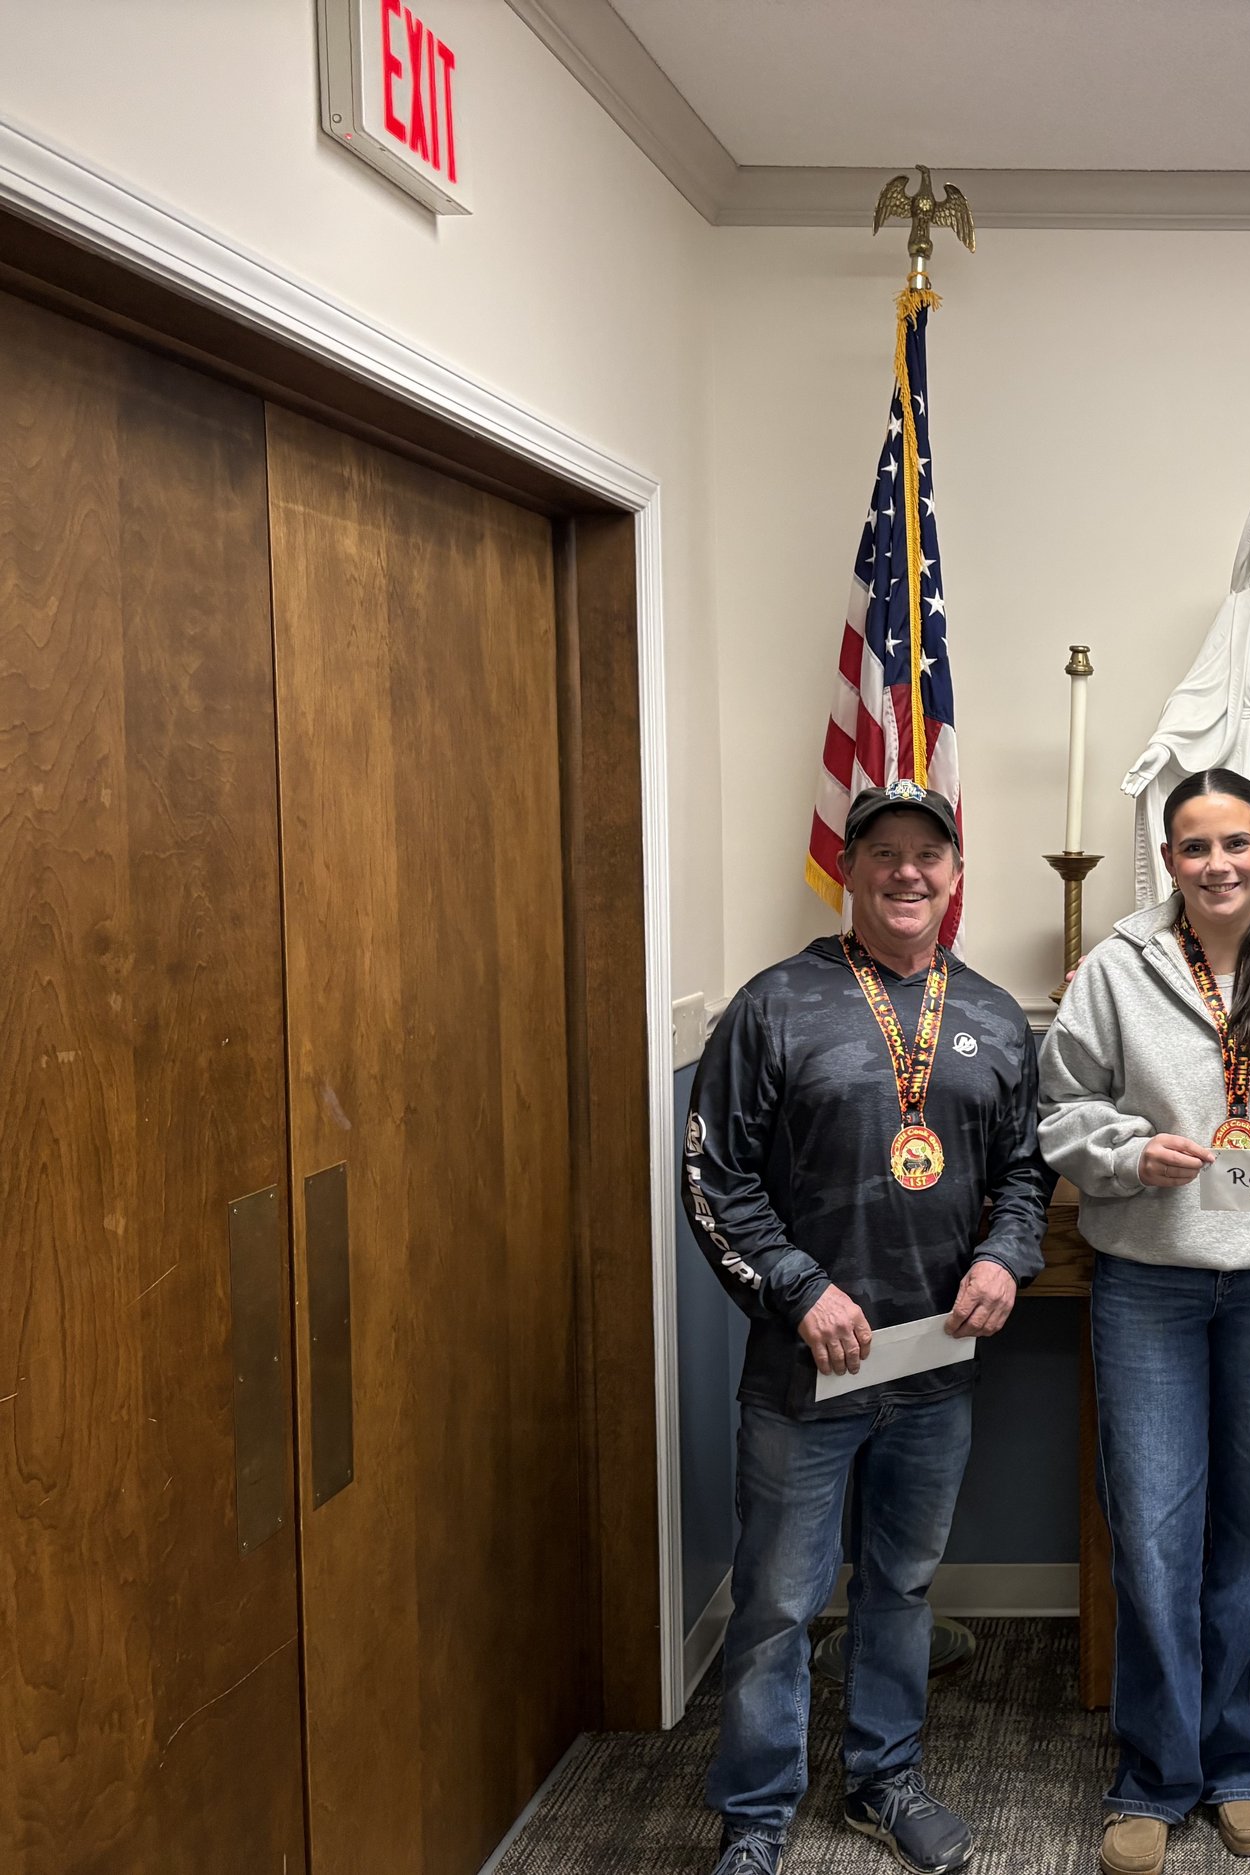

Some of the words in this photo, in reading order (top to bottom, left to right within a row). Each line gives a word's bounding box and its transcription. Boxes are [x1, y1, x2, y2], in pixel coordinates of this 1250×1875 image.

[381, 0, 457, 184] EXIT
[861, 967, 884, 1001] CHILI
[1194, 961, 1213, 999] CHILI
[907, 1064, 926, 1103] CHILI
[1235, 1056, 1249, 1096] CHILI
[909, 1177, 927, 1187] 1ST
